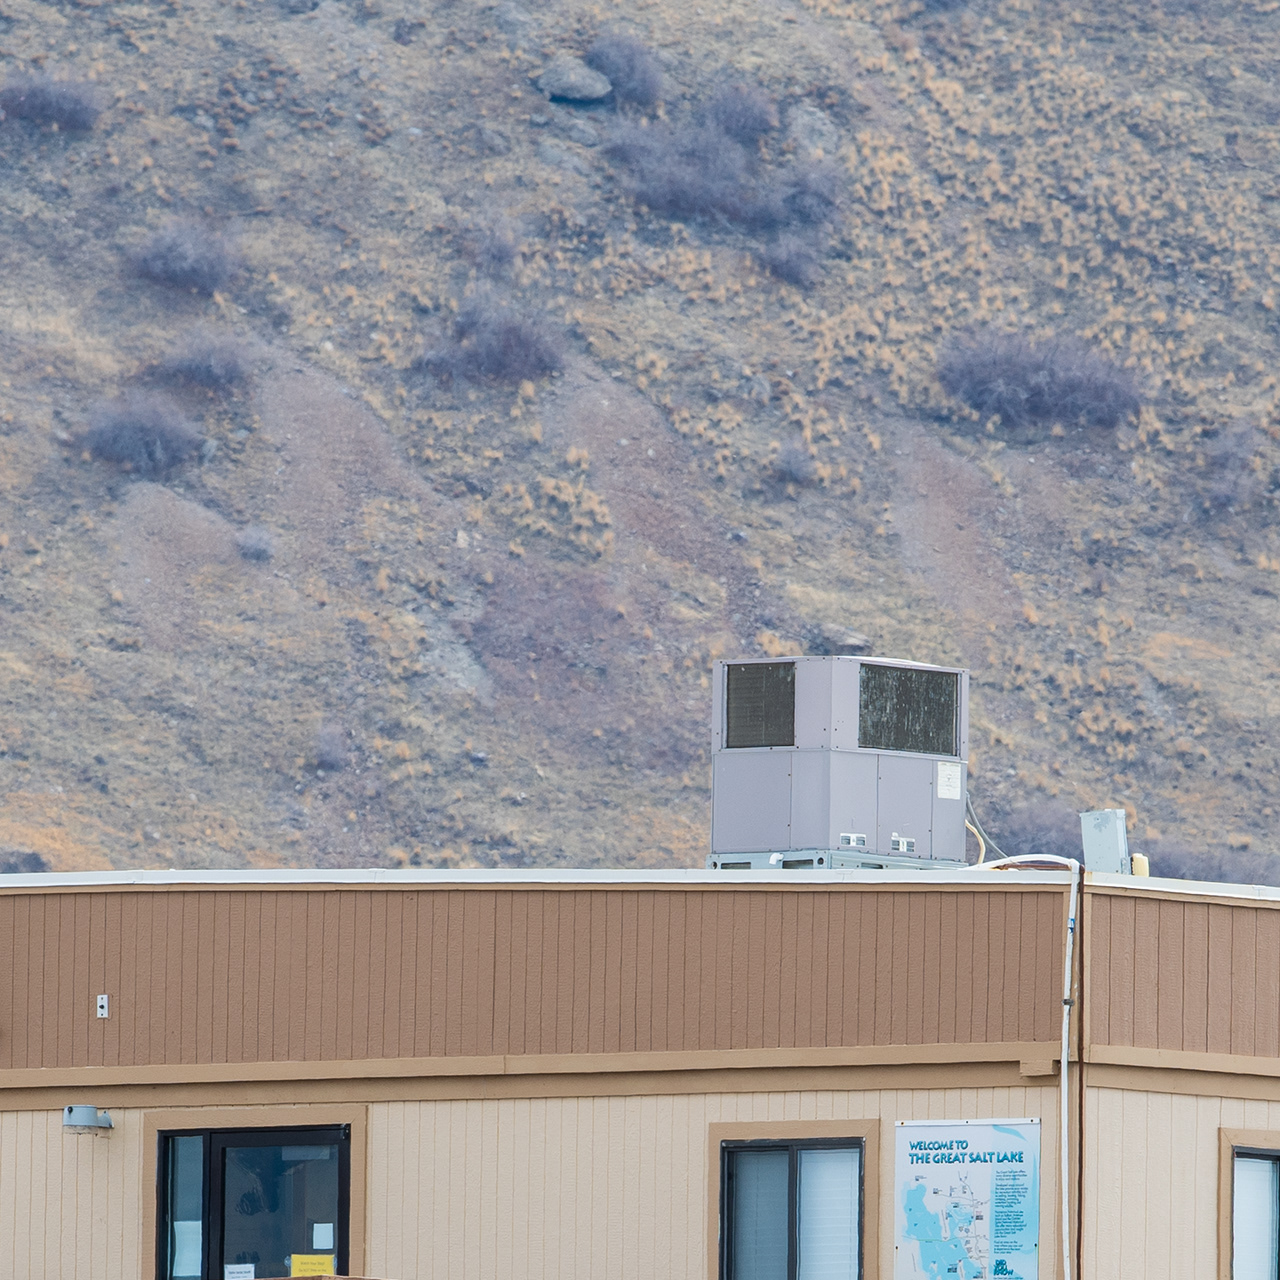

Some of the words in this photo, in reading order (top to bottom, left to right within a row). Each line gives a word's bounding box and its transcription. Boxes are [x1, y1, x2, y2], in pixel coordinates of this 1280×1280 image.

[909, 1140, 954, 1151] WELCOME
[955, 1140, 969, 1150] TO
[908, 1152, 931, 1164] THE
[932, 1152, 968, 1164] GREAT
[968, 1152, 995, 1163] SALT
[996, 1151, 1024, 1163] LAKE
